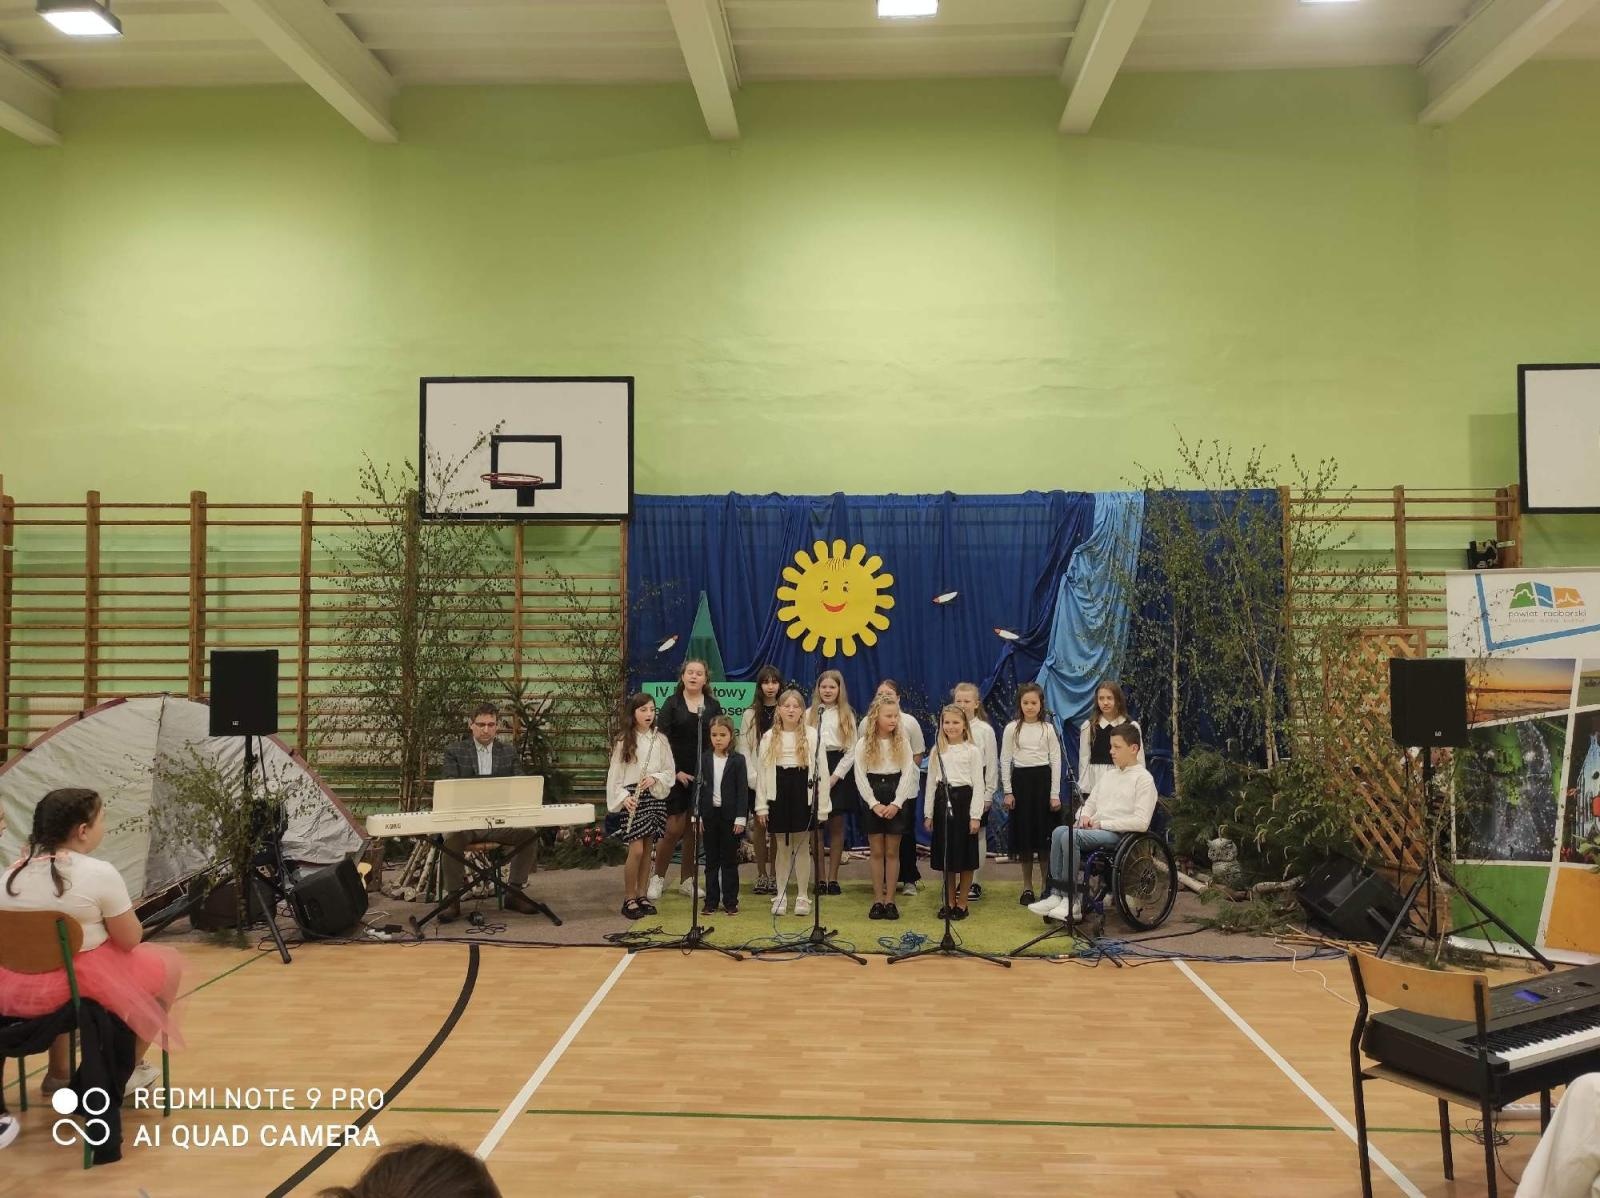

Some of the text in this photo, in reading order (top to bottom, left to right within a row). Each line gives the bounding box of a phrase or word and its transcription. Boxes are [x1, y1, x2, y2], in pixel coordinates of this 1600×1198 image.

[1508, 610, 1538, 619] powiat
[655, 686, 746, 700] IV towy
